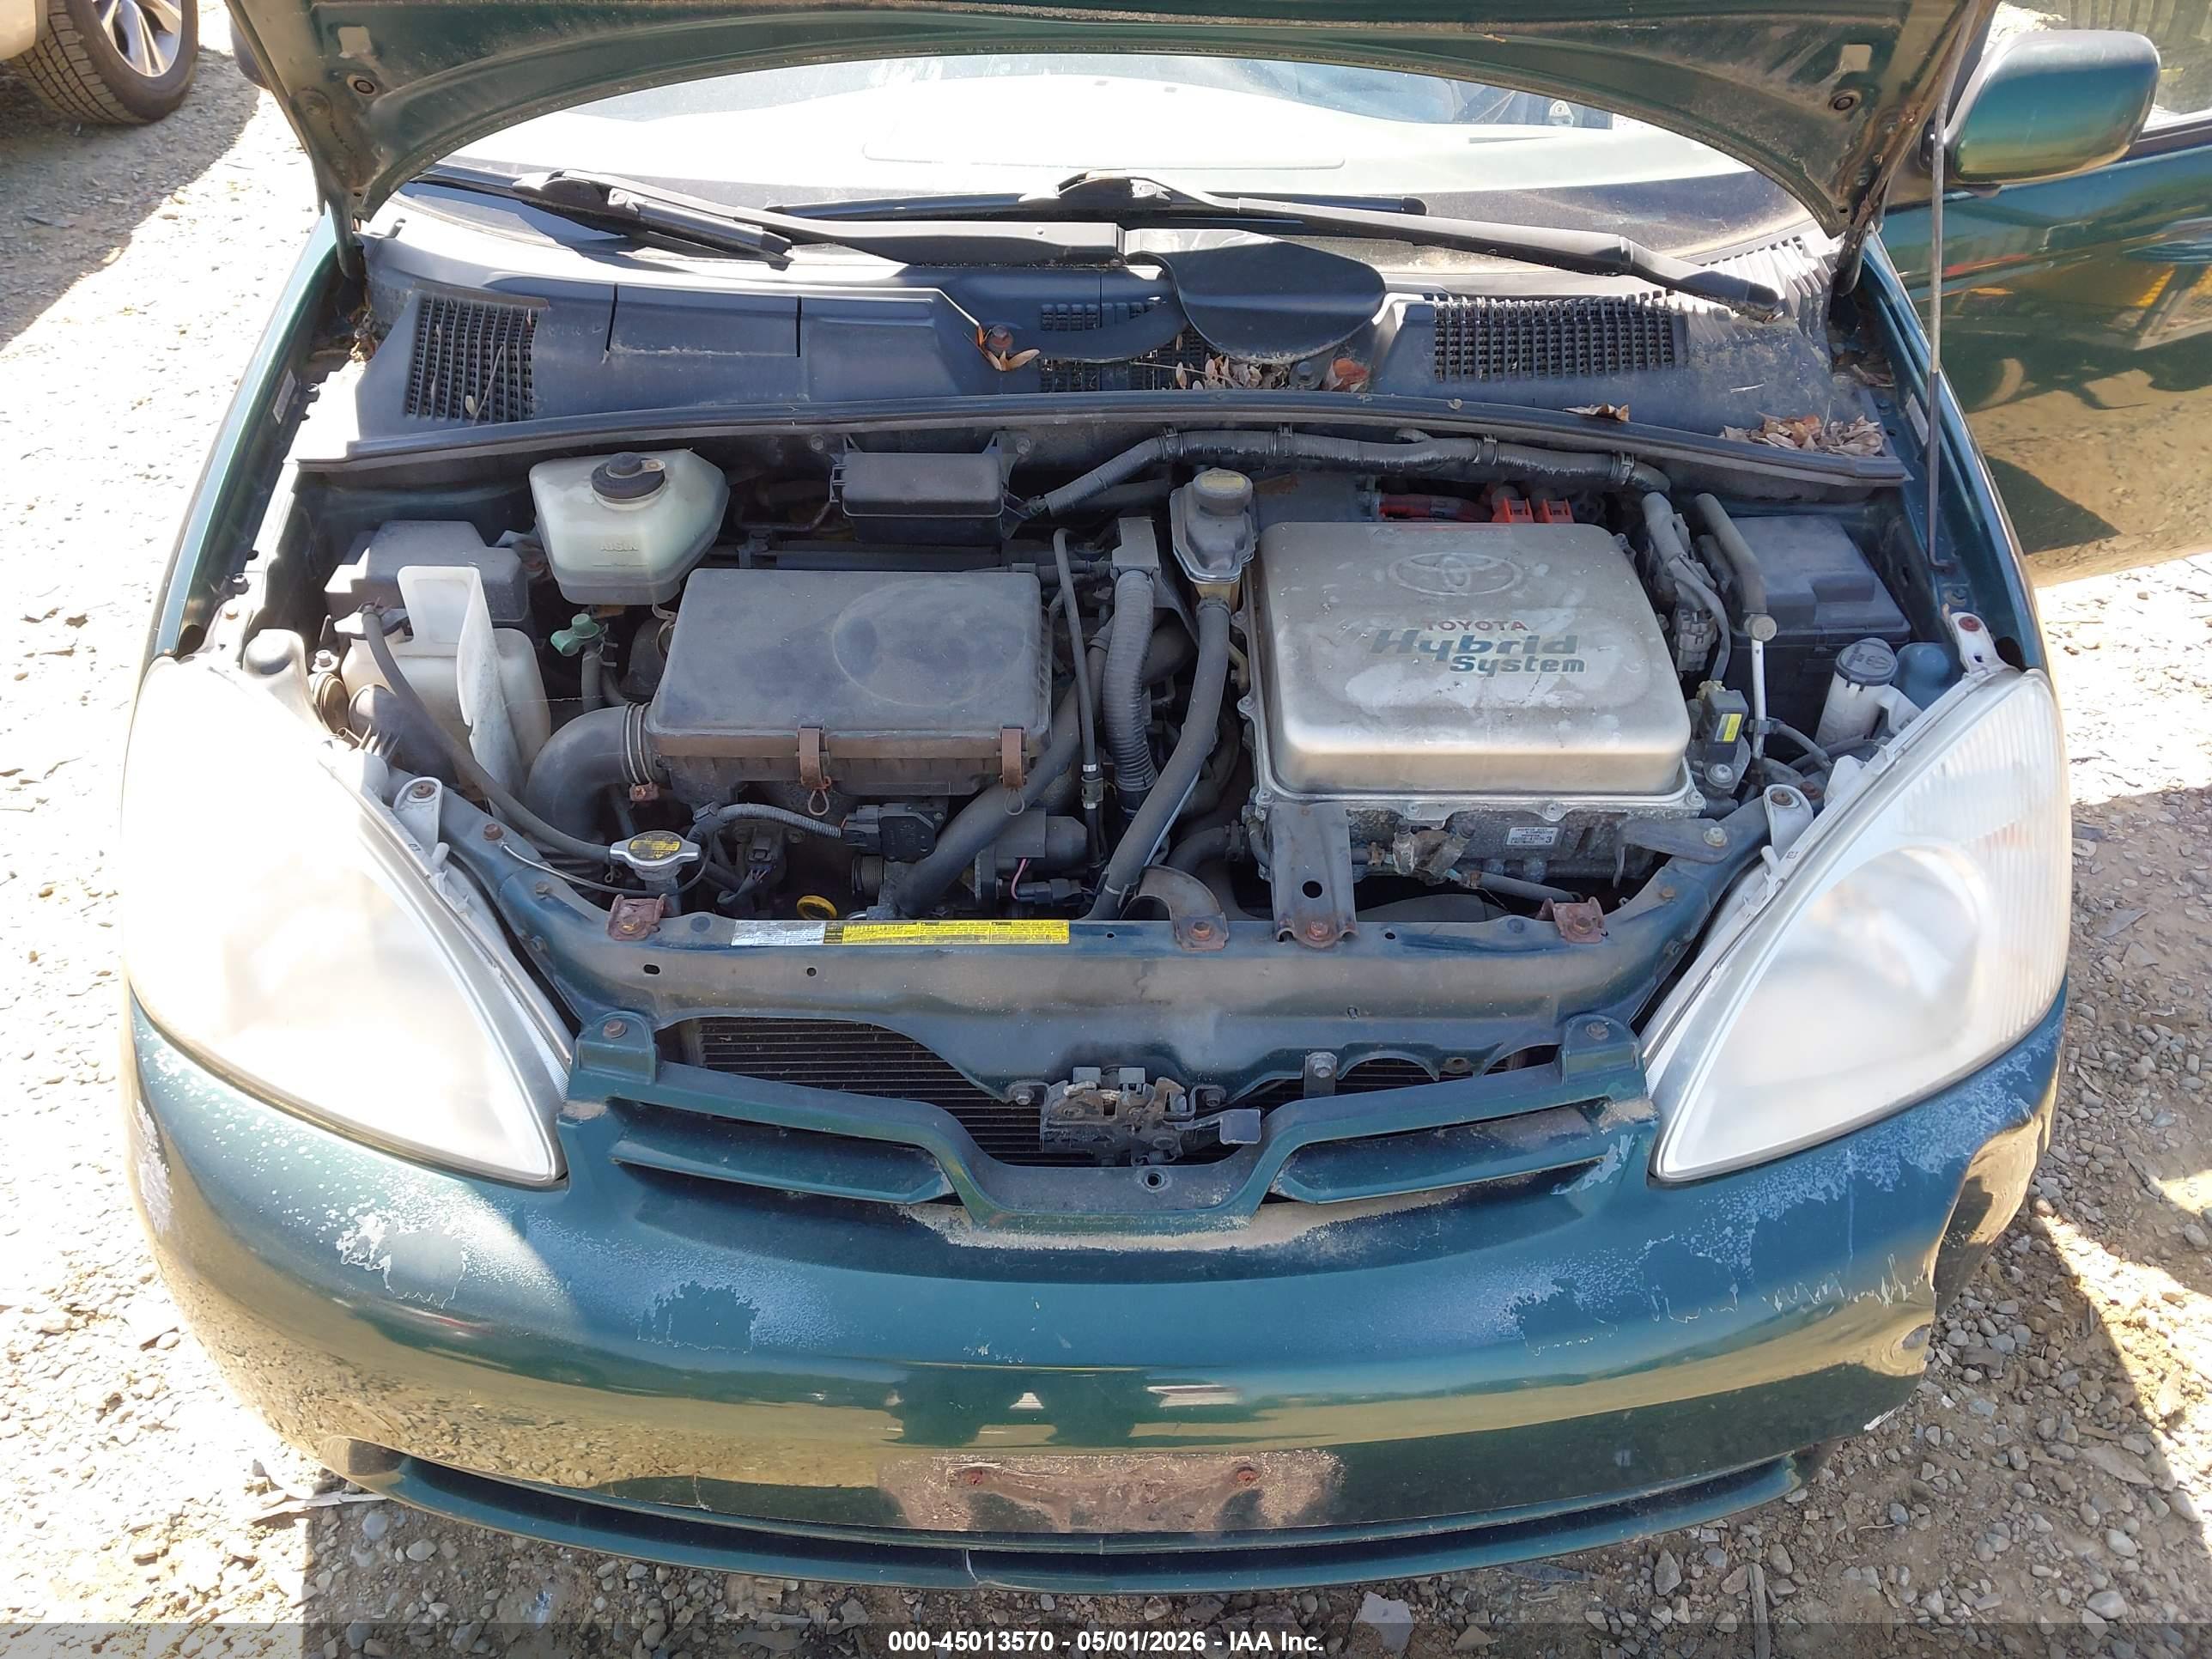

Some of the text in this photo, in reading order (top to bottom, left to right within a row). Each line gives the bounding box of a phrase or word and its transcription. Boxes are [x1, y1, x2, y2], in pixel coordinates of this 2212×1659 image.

[1422, 620, 1528, 631] TOYOTA
[1370, 629, 1578, 662] Hybrid
[1449, 655, 1585, 678] System
